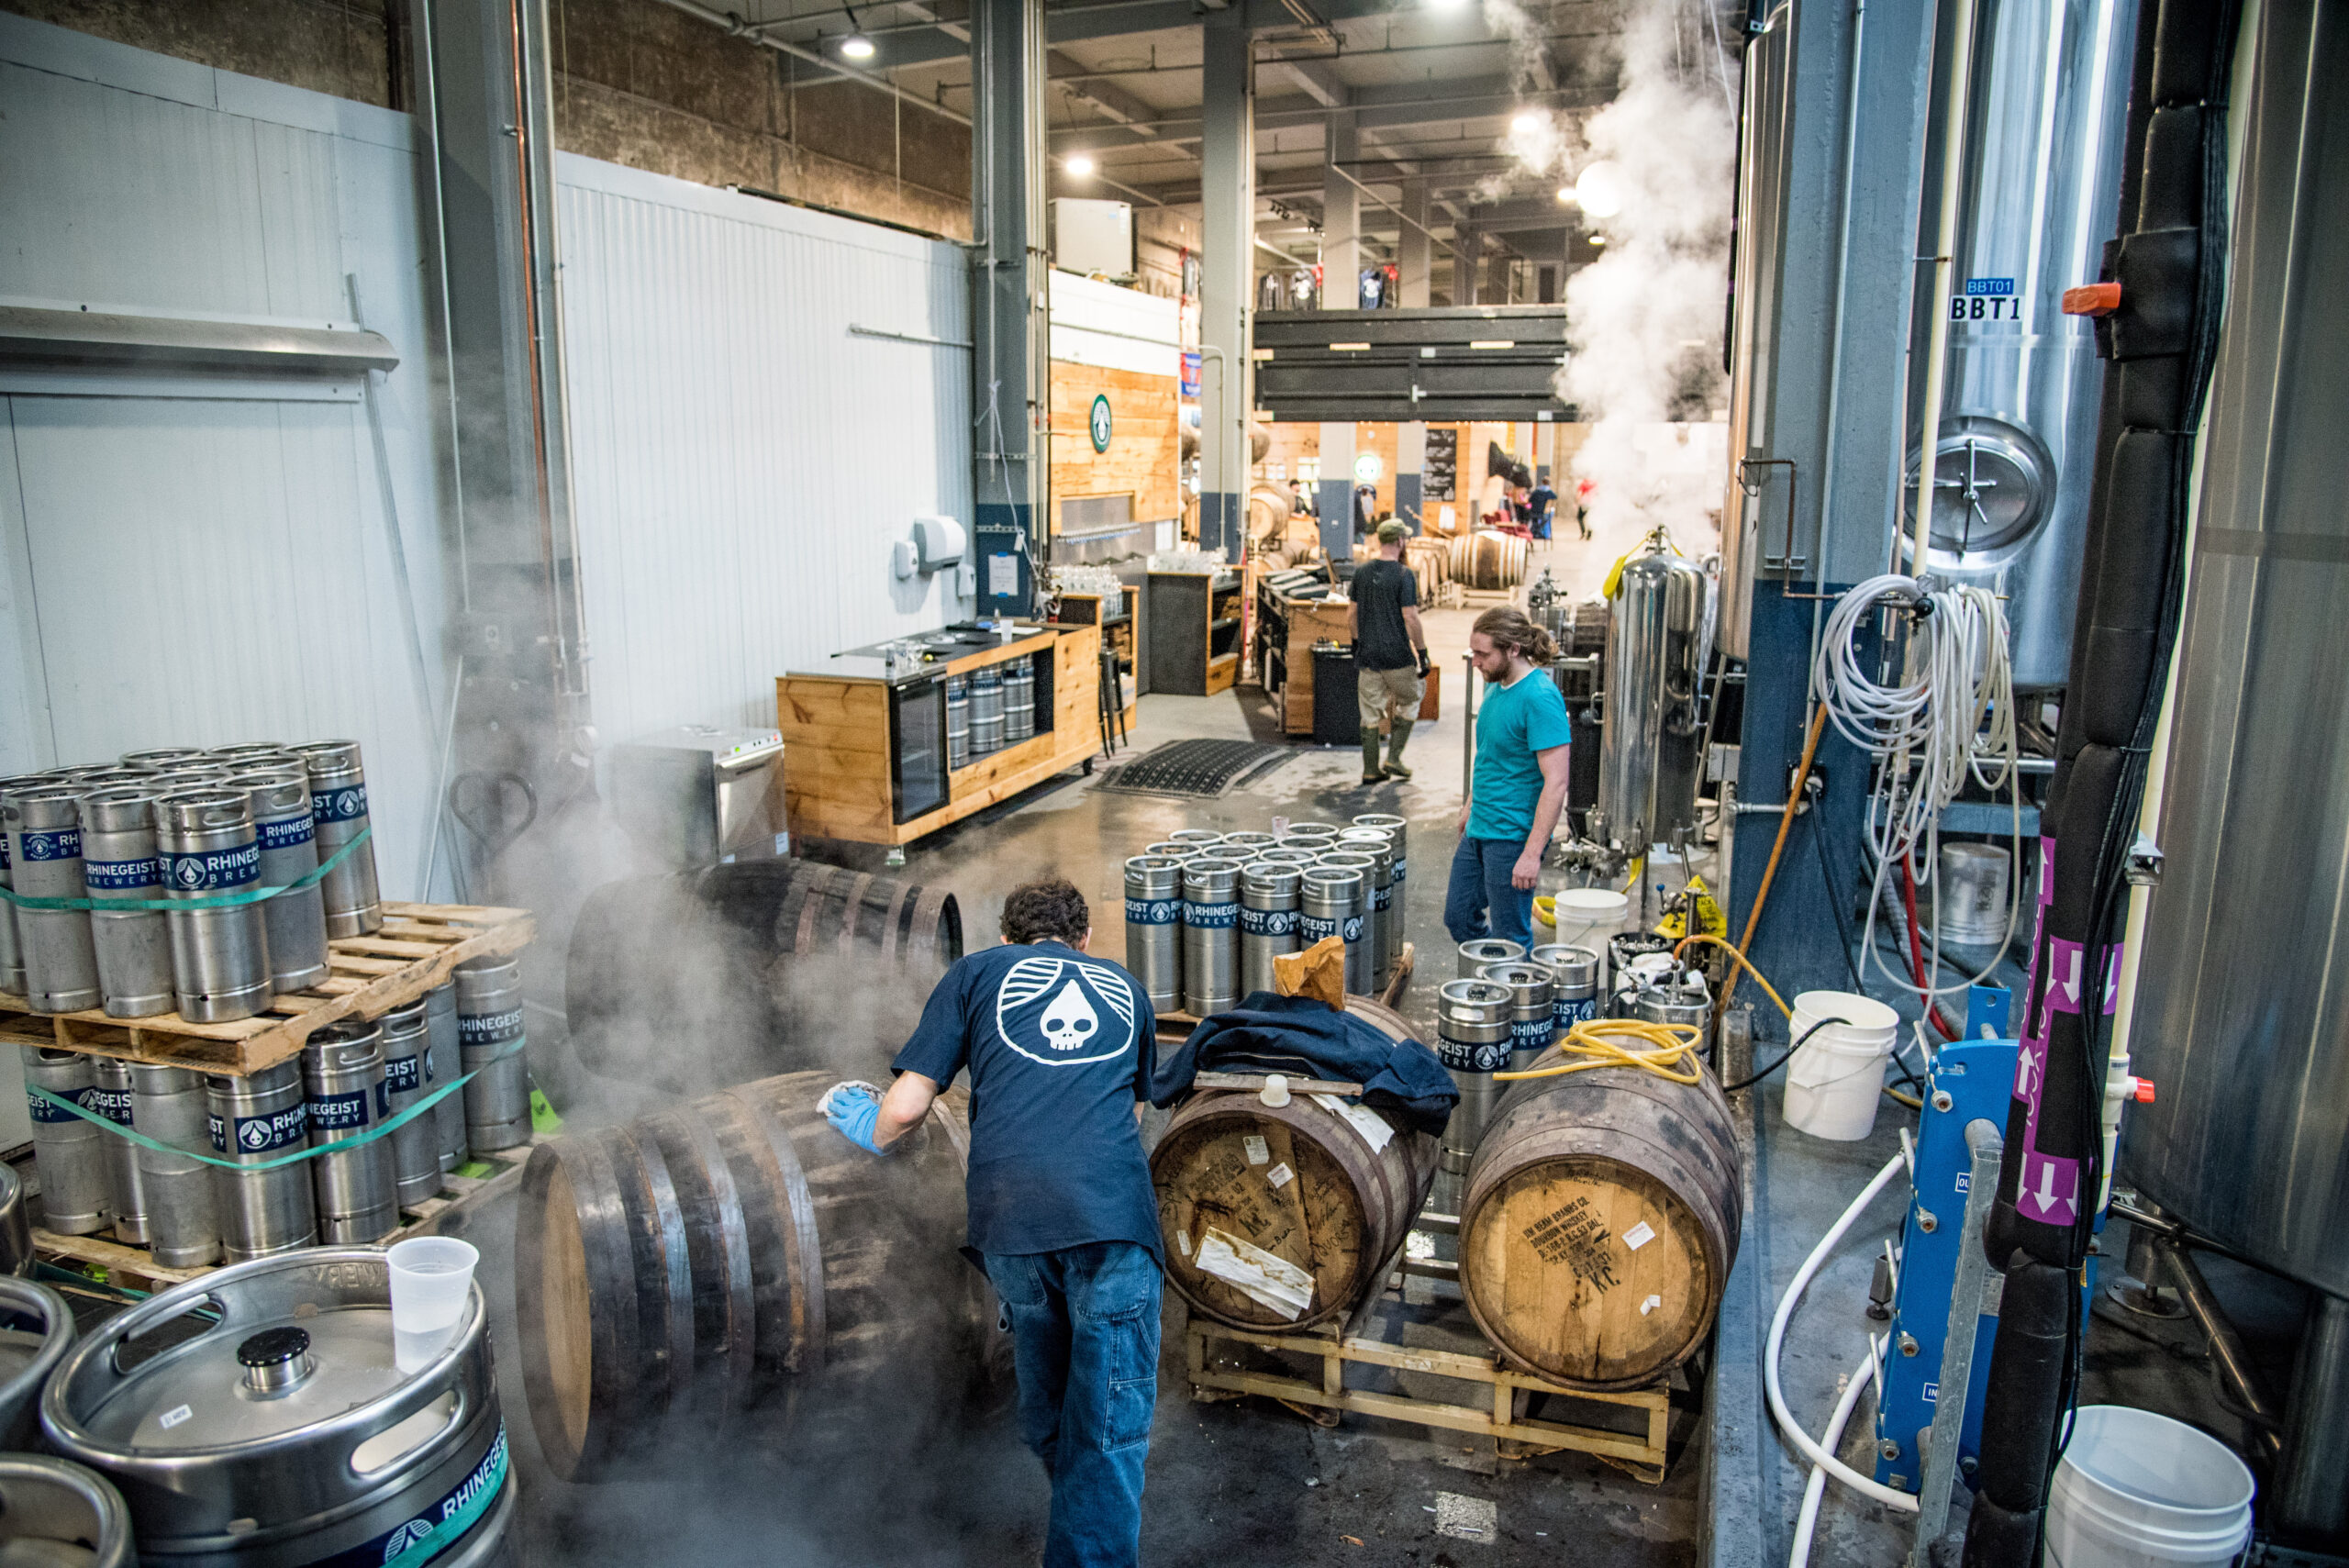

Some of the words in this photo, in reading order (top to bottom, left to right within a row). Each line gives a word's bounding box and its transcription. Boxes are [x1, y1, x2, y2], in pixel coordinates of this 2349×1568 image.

[1967, 281, 2011, 294] BBT01
[1951, 297, 2021, 320] BBT1
[86, 861, 157, 876] RHINEGEIST
[1195, 903, 1241, 917] RHINEGE
[1438, 1037, 1472, 1059] GEIST
[1531, 1227, 1561, 1249] BOURBON
[1560, 1209, 1589, 1232] WHISKEY
[1534, 1216, 1553, 1233] BEAM
